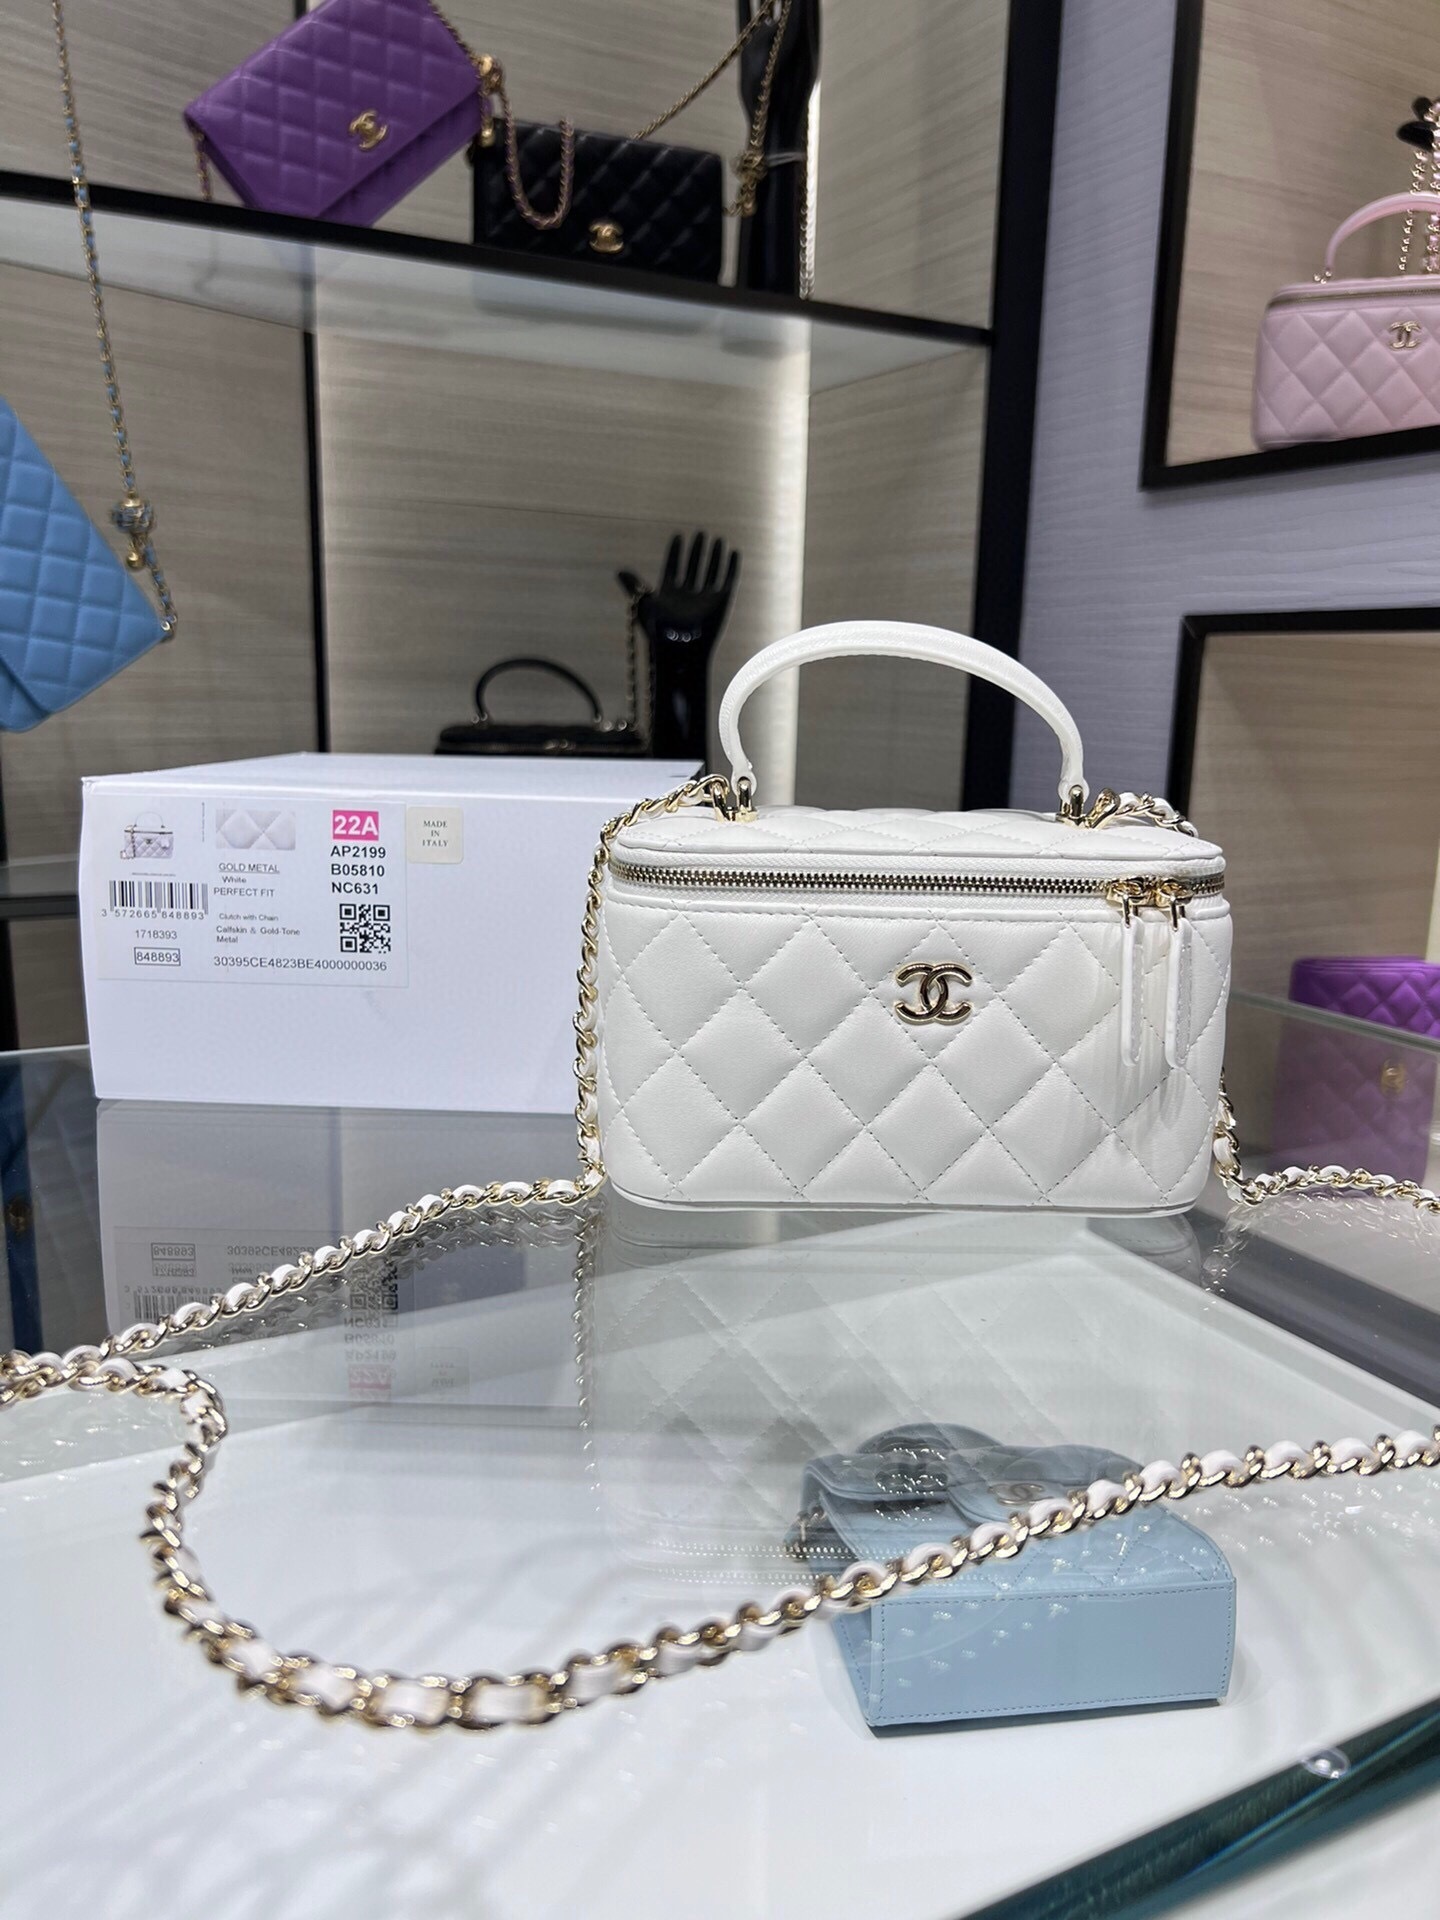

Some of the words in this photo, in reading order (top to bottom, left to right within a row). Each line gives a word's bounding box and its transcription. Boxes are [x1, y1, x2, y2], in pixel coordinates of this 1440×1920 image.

[334, 815, 378, 836] 22A
[423, 820, 448, 828] MADE
[422, 839, 448, 847] ITALY
[330, 845, 386, 858] AP2199
[219, 863, 246, 872] GOLD
[248, 863, 280, 873] METAL
[331, 863, 385, 877] B05810
[213, 887, 258, 896] PERFECT
[260, 889, 275, 897] FIT
[331, 882, 378, 894] NC631
[216, 925, 247, 933] Calfskin
[135, 929, 178, 940] 1718393
[216, 935, 238, 943] Metal
[136, 951, 179, 962] 848893
